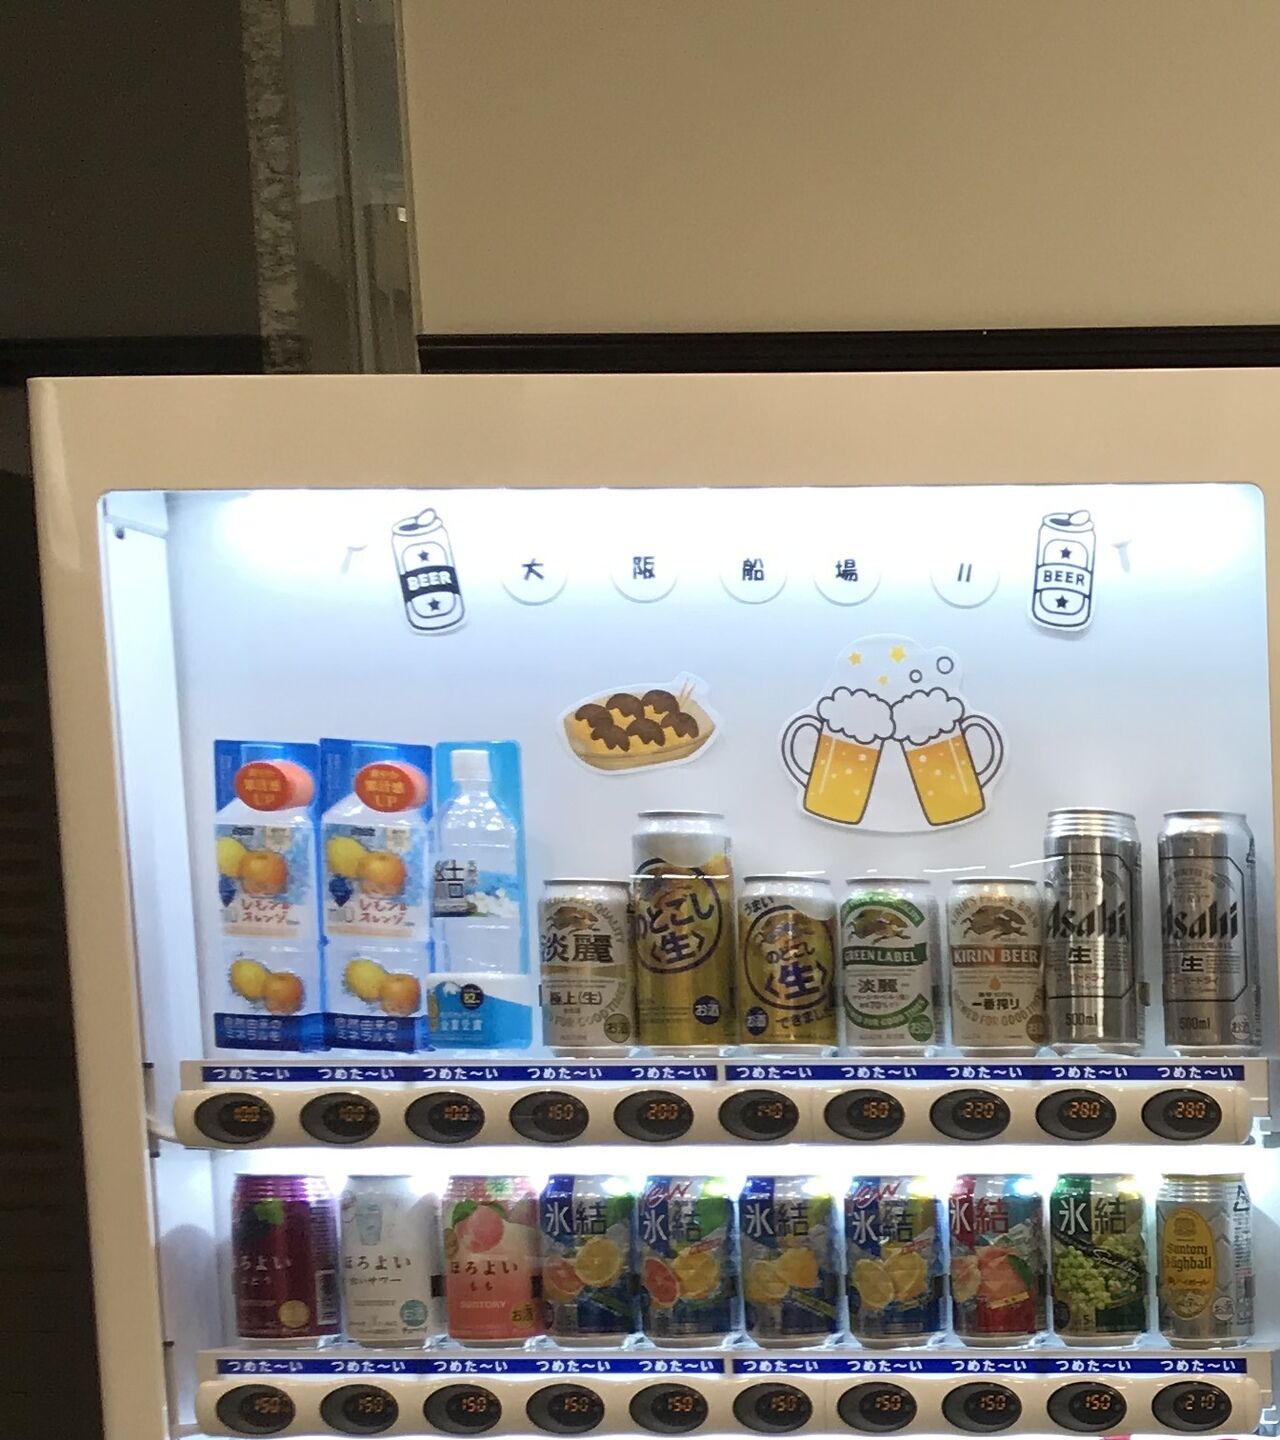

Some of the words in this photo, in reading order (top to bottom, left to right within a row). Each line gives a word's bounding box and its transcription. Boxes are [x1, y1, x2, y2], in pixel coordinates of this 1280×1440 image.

[406, 571, 452, 592] BEER
[1043, 569, 1085, 587] BEER
[541, 934, 613, 963] 淡麗
[953, 945, 995, 964] KIRIN
[1001, 945, 1039, 963] BEER
[1068, 946, 1093, 965] 生
[1181, 956, 1204, 973] 生
[694, 1003, 720, 1017] お酒
[1065, 1012, 1098, 1027] 500ml
[1179, 1017, 1211, 1030] 500ml
[546, 1202, 607, 1237] 氷結
[746, 1200, 811, 1237] 氷結
[950, 1198, 1009, 1235] 氷結
[1059, 1198, 1128, 1236] 氷結
